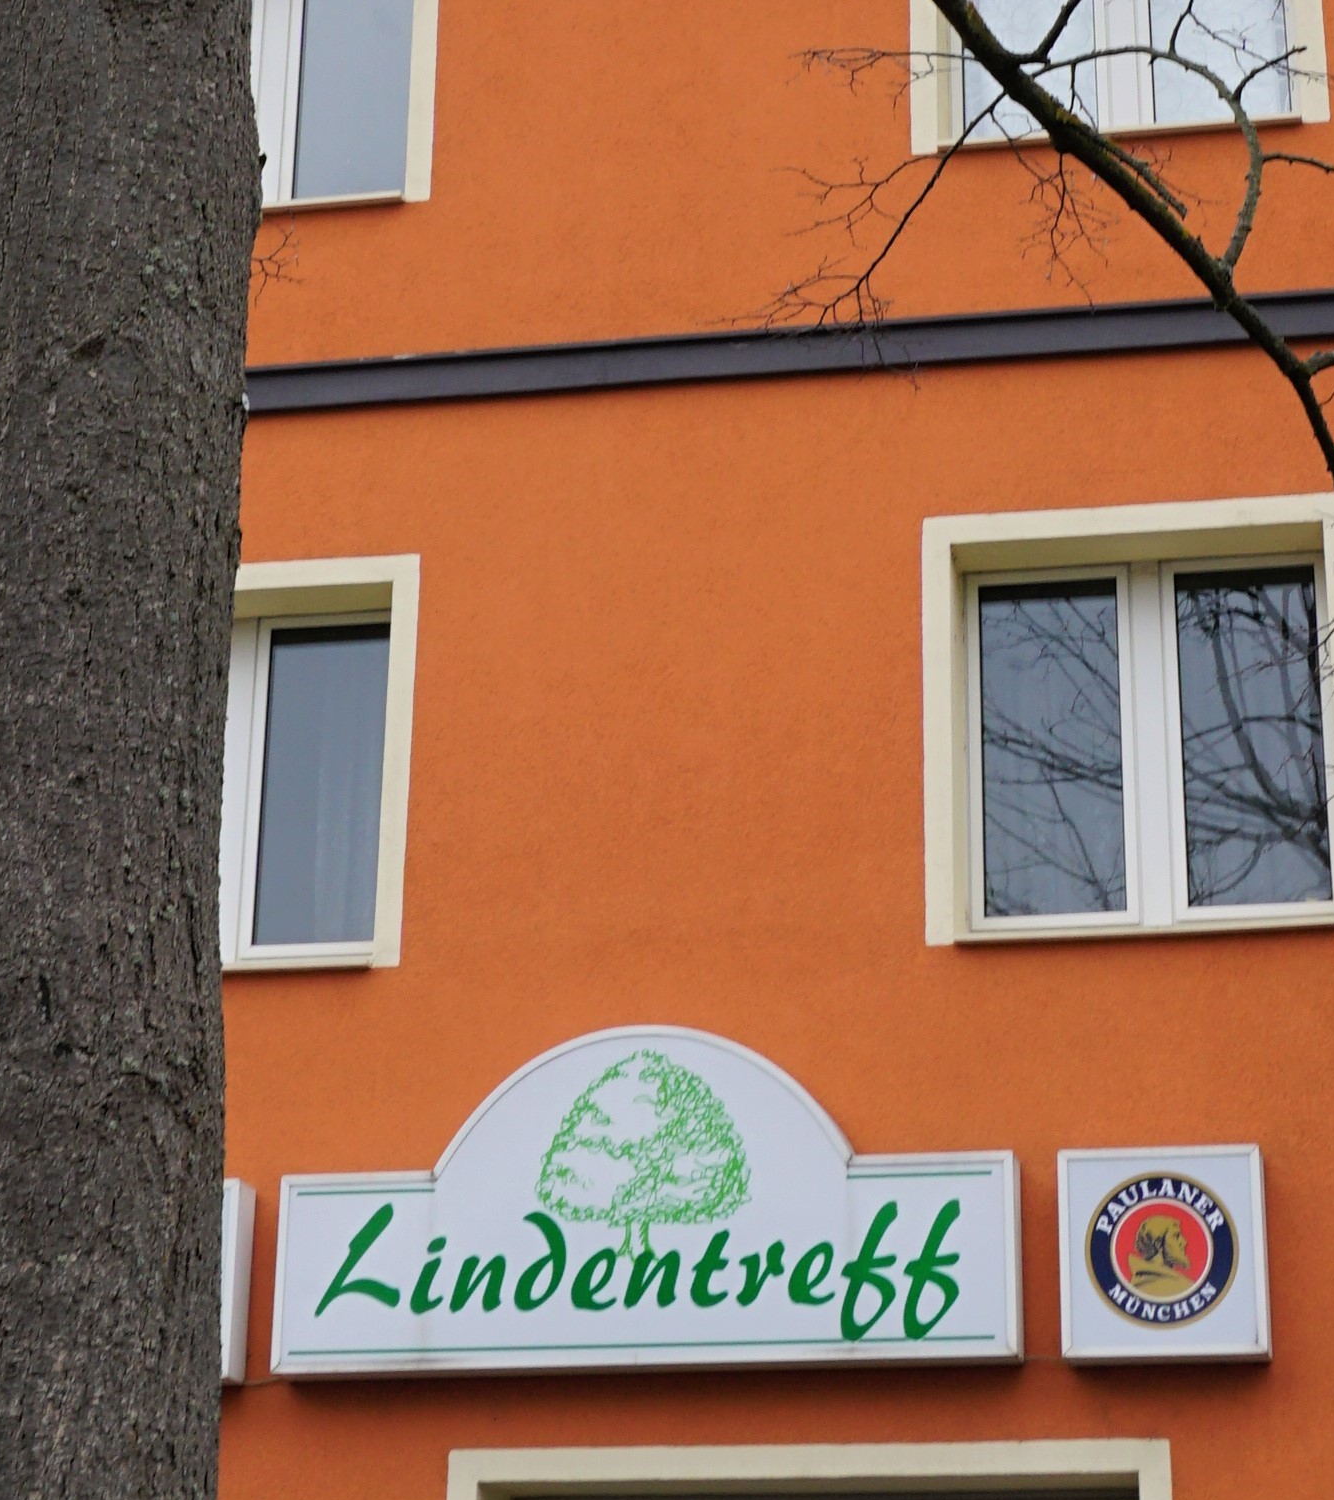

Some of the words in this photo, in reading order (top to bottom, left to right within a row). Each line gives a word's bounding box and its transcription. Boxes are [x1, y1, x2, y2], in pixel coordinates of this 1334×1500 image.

[1096, 1178, 1224, 1236] PAULANER
[314, 1199, 960, 1341] Lindentreff
[1108, 1282, 1218, 1322] MÜNCHEN
